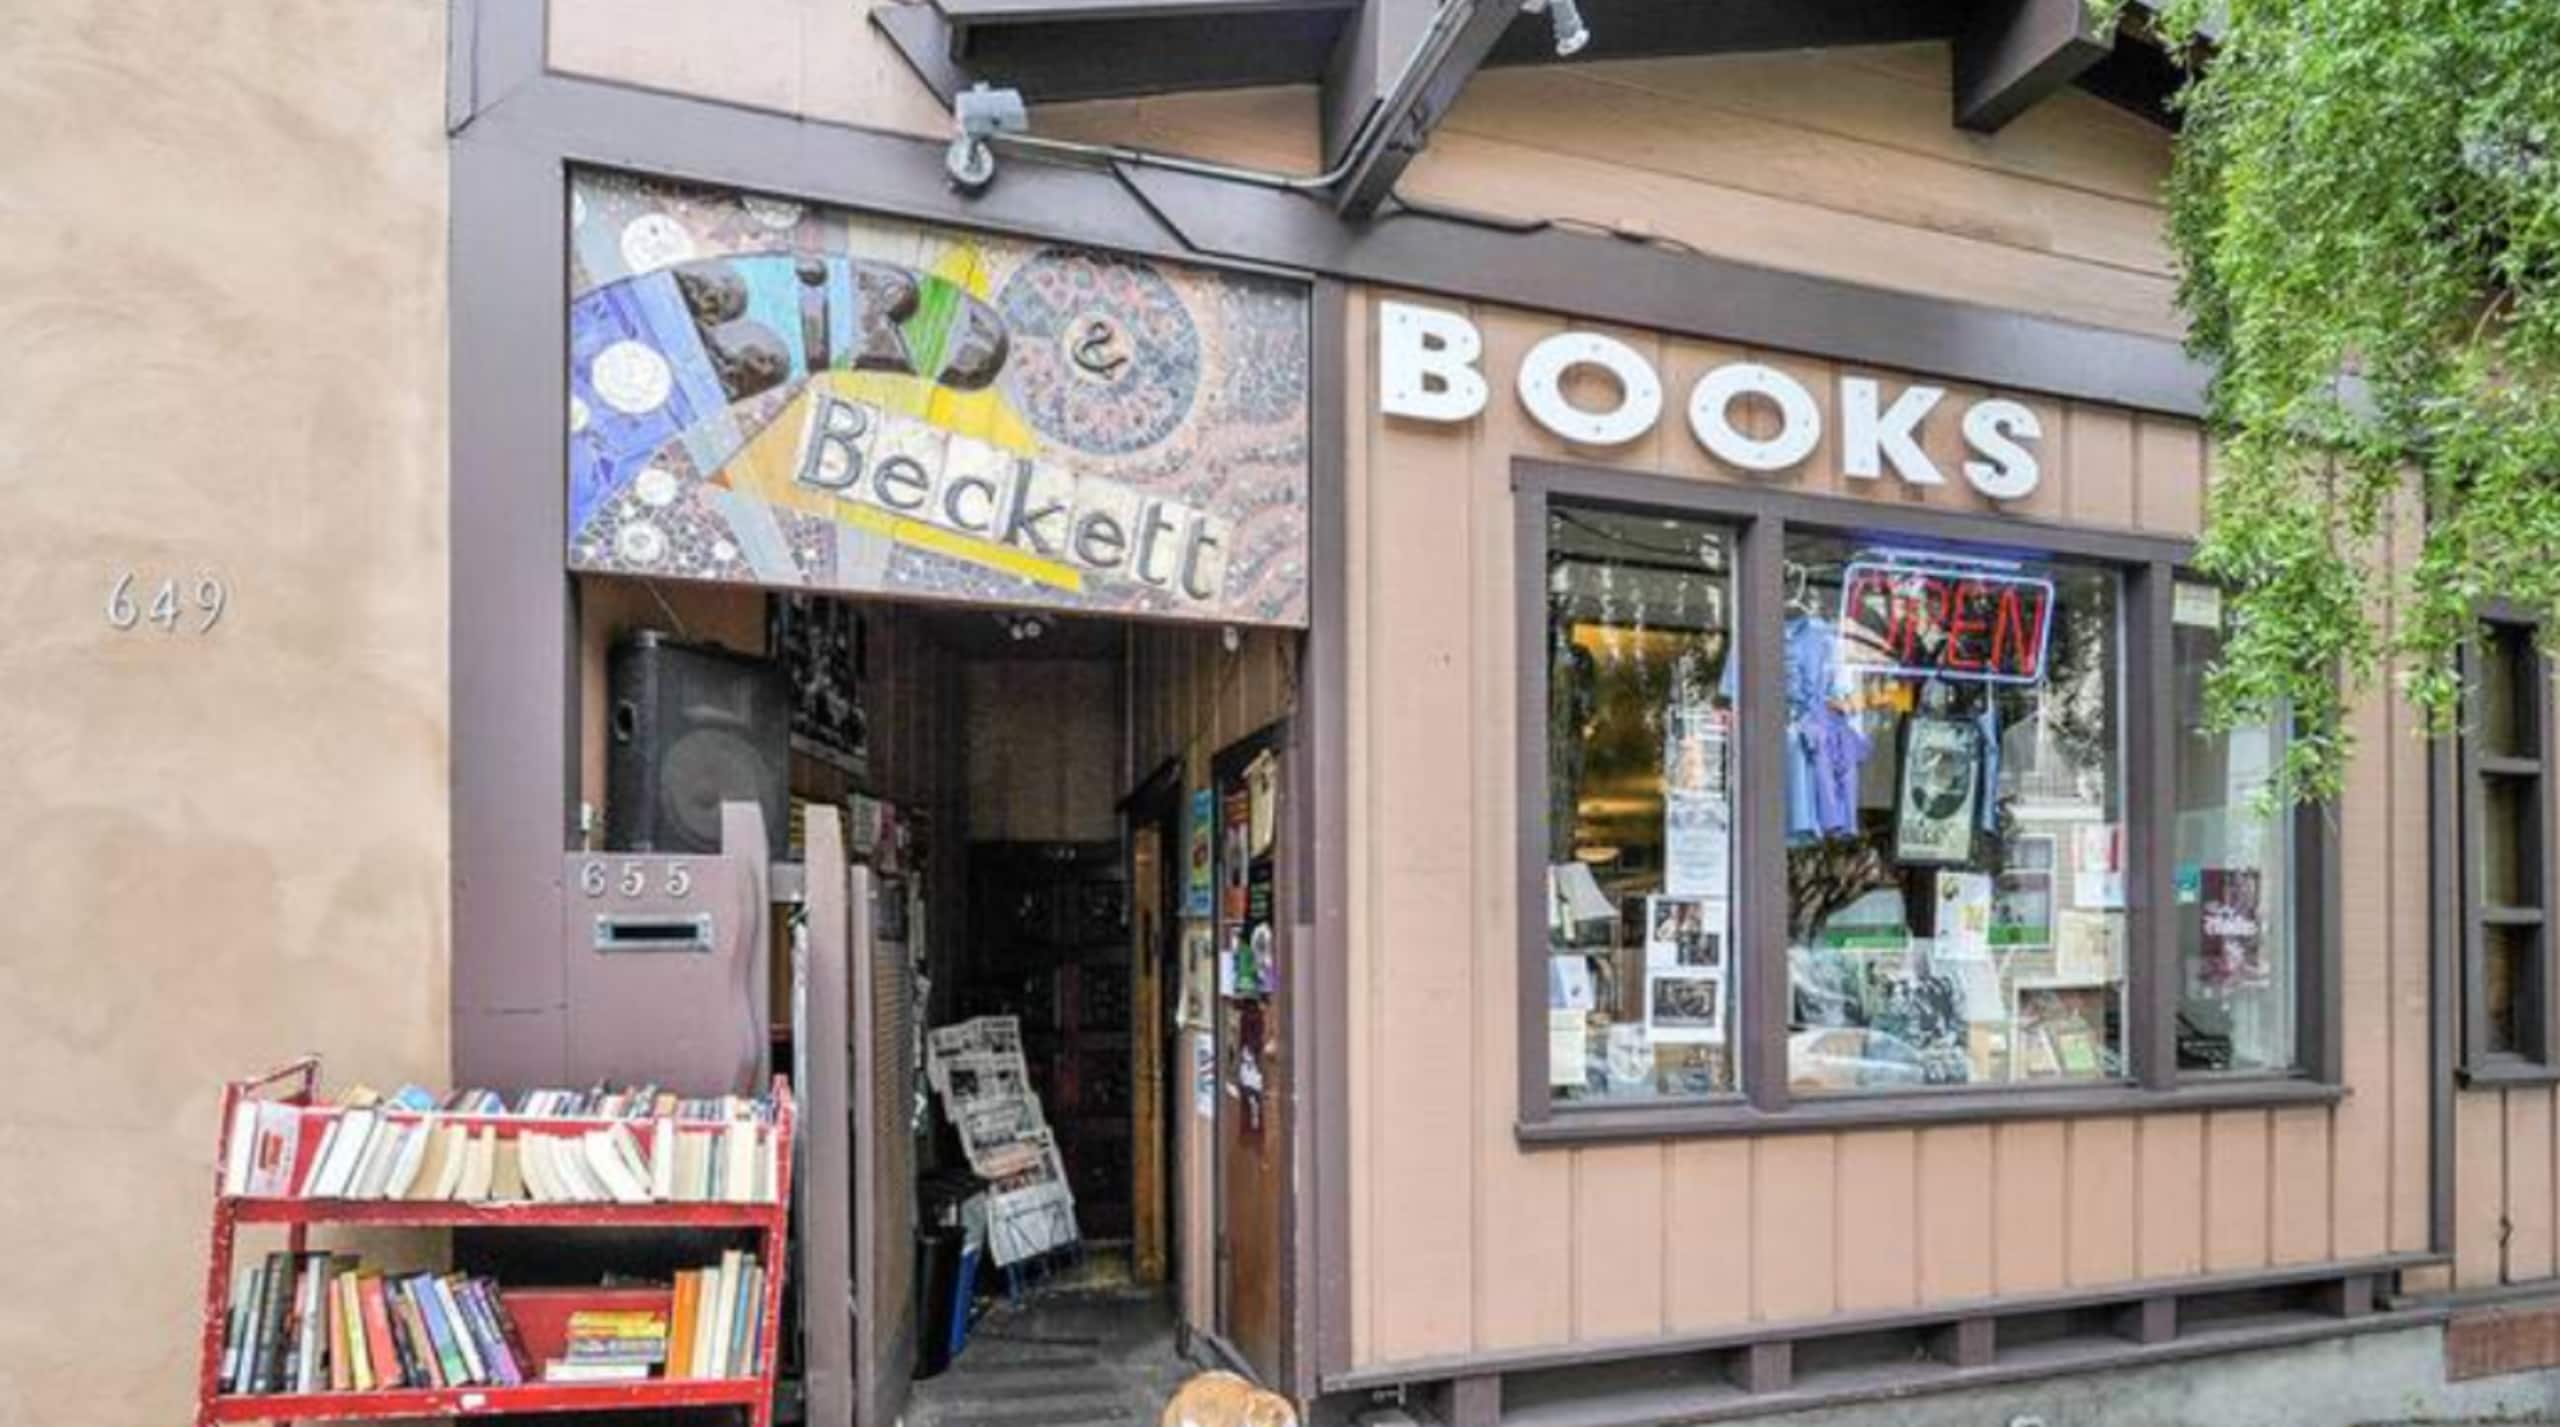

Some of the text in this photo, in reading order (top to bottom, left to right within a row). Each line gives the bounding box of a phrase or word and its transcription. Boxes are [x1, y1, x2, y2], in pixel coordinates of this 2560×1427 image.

[1072, 320, 1129, 380] &
[1379, 300, 2044, 500] BOOKS
[796, 393, 1226, 602] Beckett
[105, 571, 228, 634] 649
[1849, 571, 2046, 677] OPEN
[581, 860, 691, 898] 655
